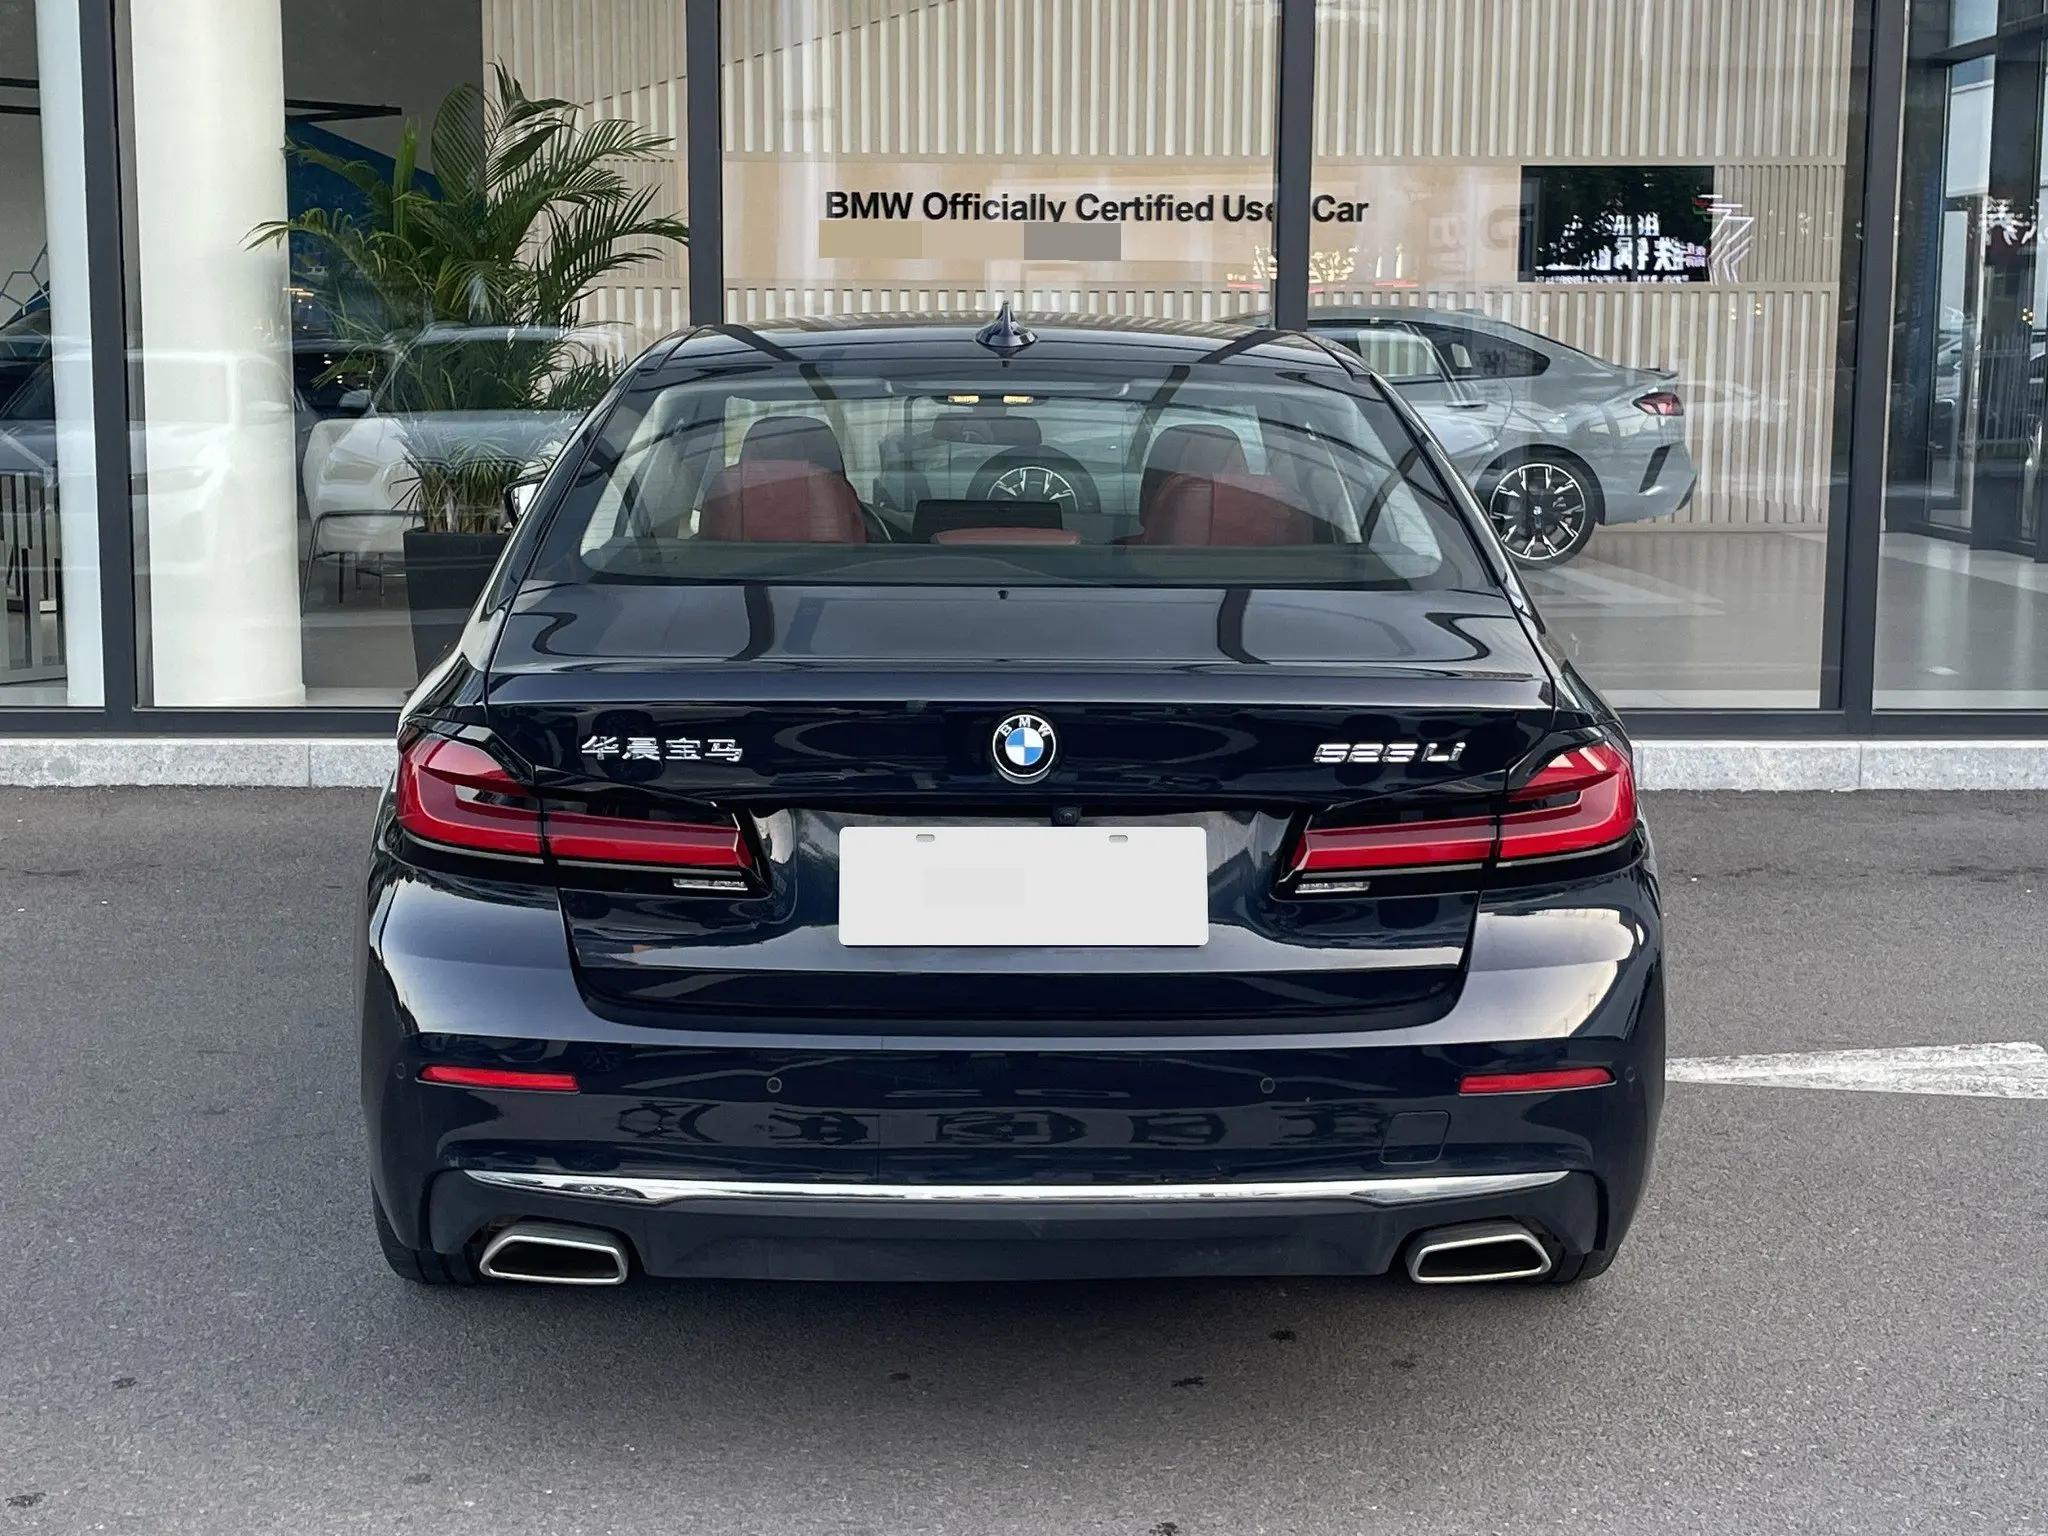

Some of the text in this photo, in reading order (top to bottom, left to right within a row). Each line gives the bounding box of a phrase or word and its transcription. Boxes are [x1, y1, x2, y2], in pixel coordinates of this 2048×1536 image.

[825, 191, 914, 220] BMW
[922, 191, 1067, 222] Officially
[1075, 193, 1214, 222] Certified
[1311, 194, 1369, 222] Car
[1000, 715, 1051, 737] BMW
[581, 735, 743, 762] 华晨宝马
